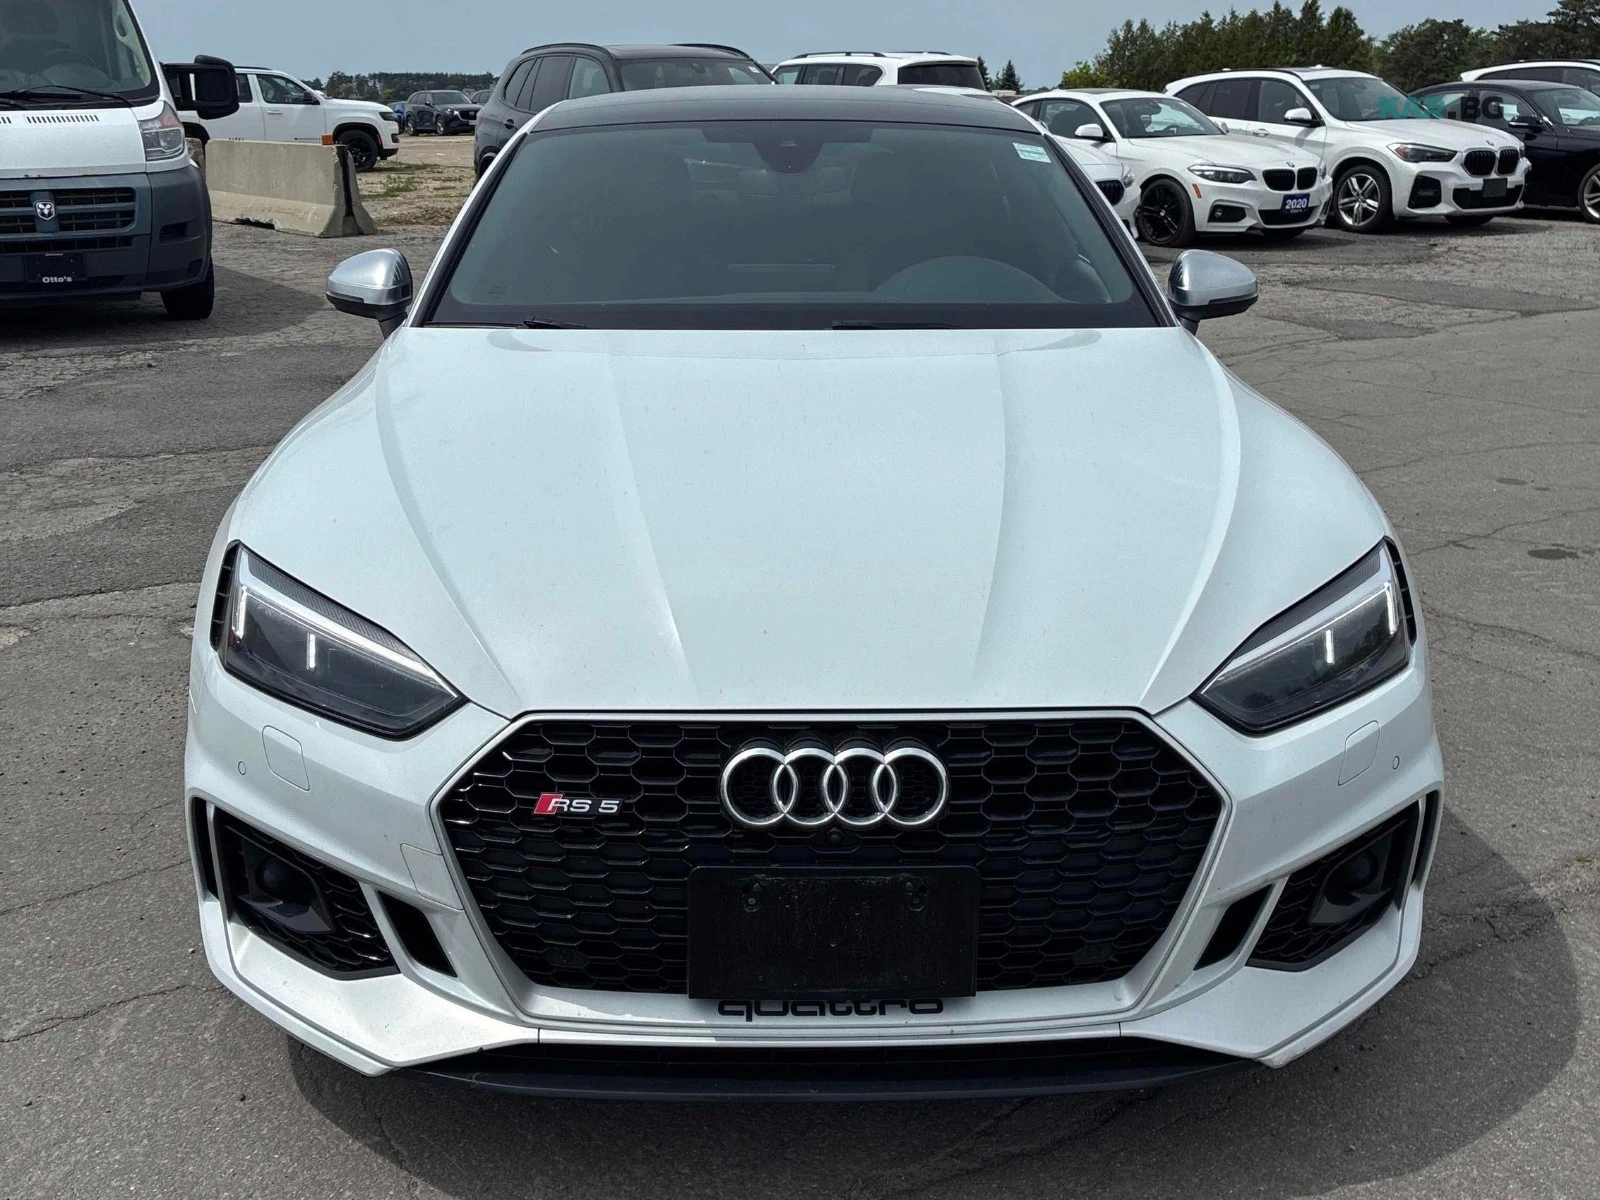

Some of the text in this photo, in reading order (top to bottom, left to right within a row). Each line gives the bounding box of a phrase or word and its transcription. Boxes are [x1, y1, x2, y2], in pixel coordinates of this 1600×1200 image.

[1285, 198, 1308, 210] 2020
[42, 276, 73, 284] Otto's
[547, 798, 620, 814] RS 5
[717, 998, 945, 1023] quattro
